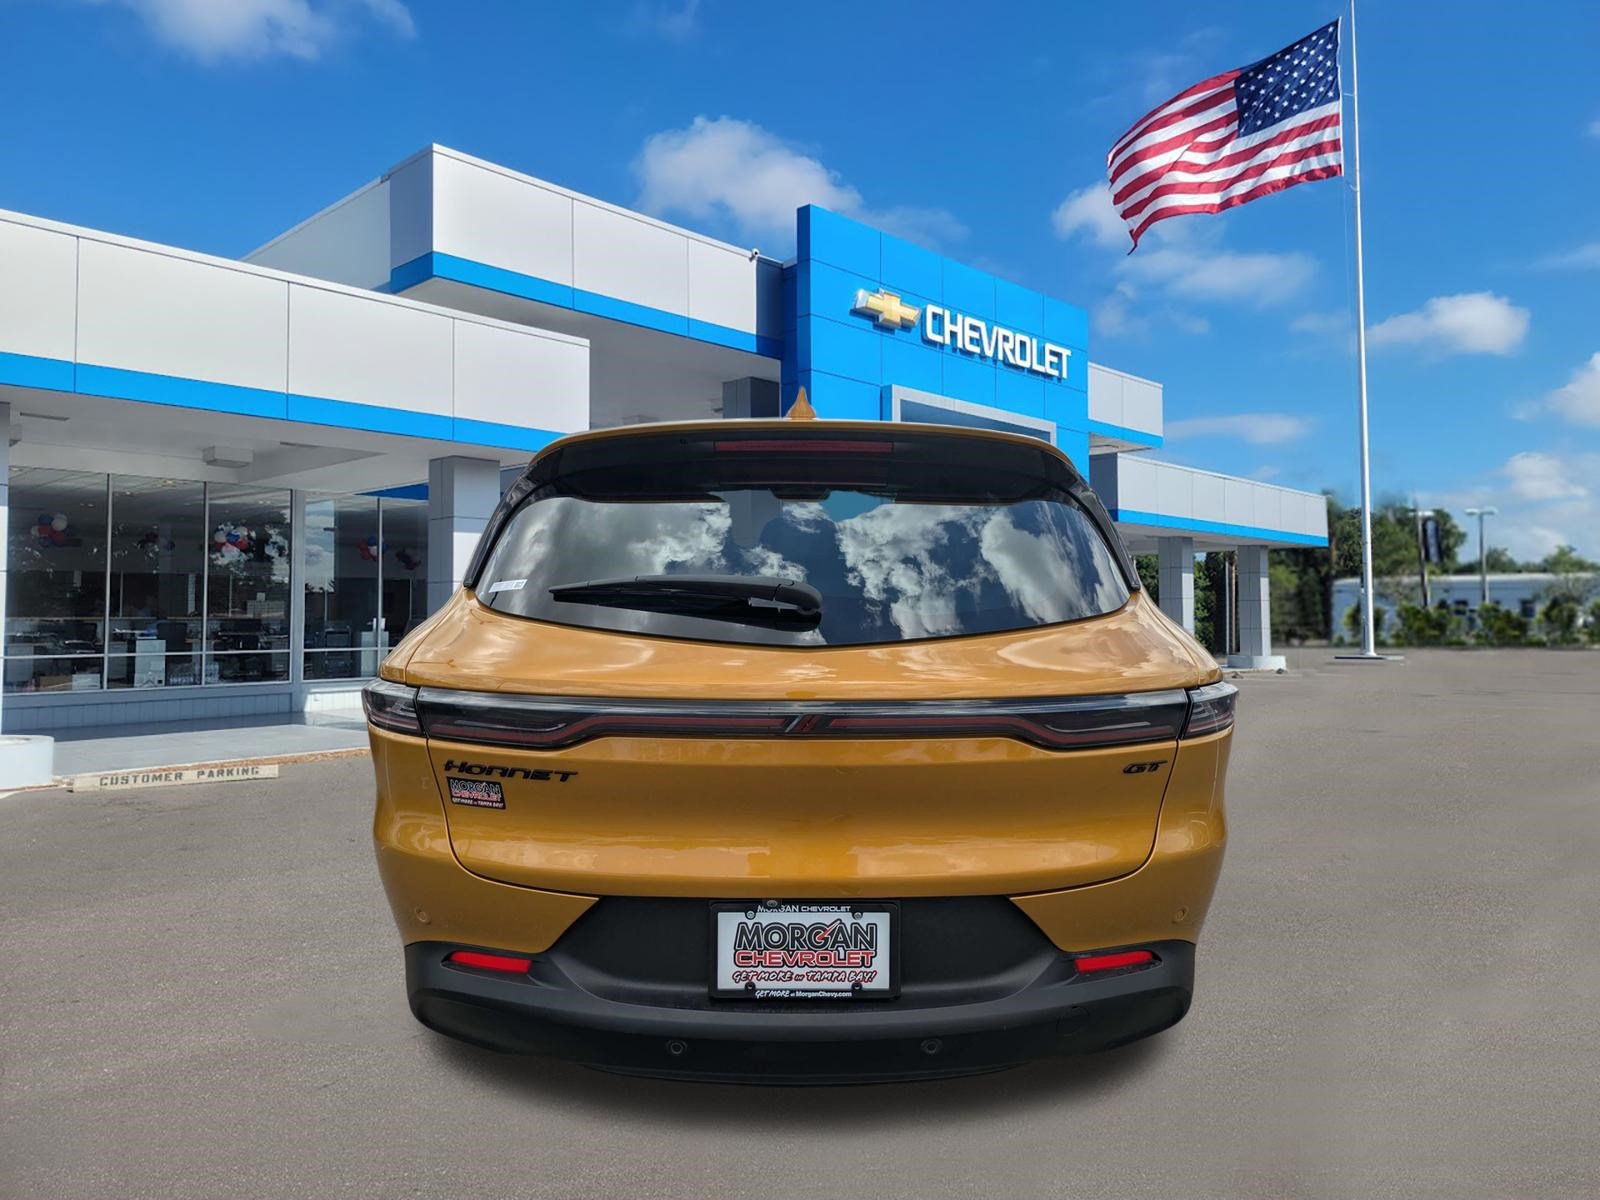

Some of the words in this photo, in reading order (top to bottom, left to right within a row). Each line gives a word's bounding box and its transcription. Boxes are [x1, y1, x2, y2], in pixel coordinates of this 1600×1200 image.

[922, 303, 1072, 379] CHEVROLET
[1123, 760, 1168, 773] GT
[99, 772, 183, 786] CUSTOMER
[196, 766, 259, 779] PARKING
[449, 779, 501, 793] MORGAN
[734, 919, 877, 950] MORGAN
[734, 950, 877, 967] CHEVROLET
[732, 970, 757, 983] GET
[757, 970, 793, 981] MORE
[806, 970, 846, 981] TAMPA
[847, 970, 877, 982] BAY!
[755, 990, 769, 999] GET
[768, 990, 790, 998] MORE
